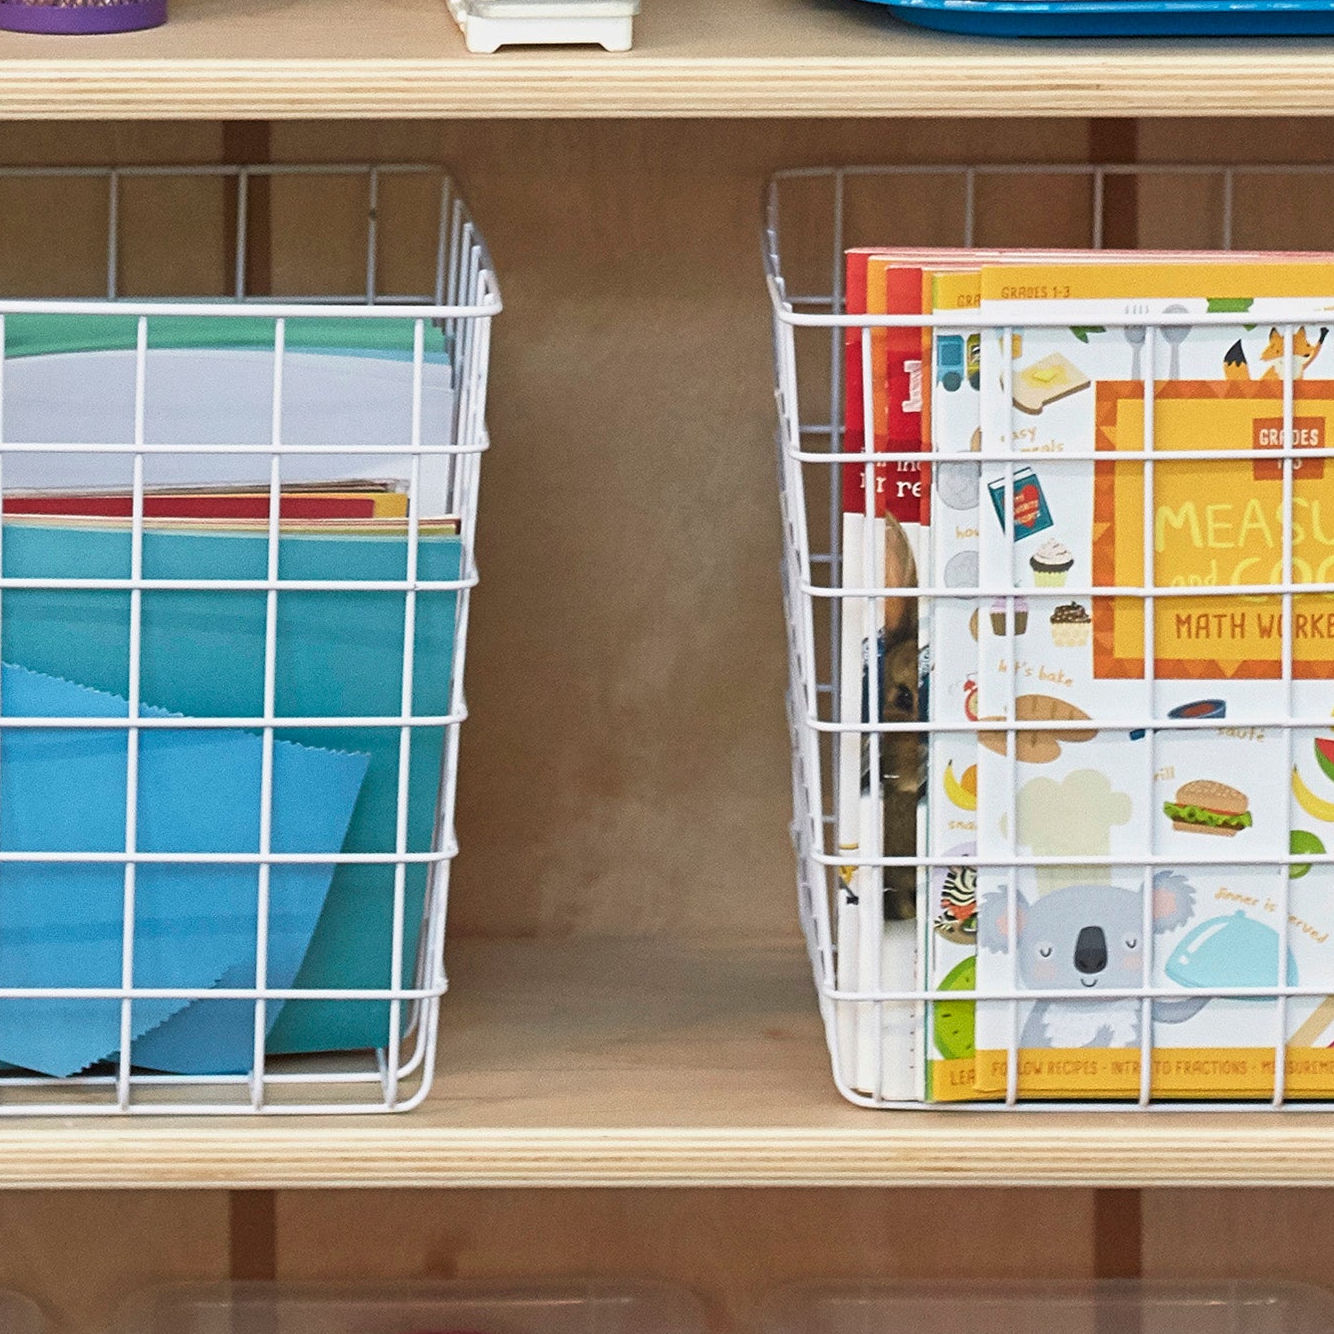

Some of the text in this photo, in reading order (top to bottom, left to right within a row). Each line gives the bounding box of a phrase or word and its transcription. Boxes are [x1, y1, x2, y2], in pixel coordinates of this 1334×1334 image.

[1001, 286, 1071, 300] GRADES 1-3
[1175, 613, 1246, 639] MATH
[1153, 765, 1175, 781] rill
[1288, 915, 1329, 944] erved
[991, 1061, 1043, 1076] FOLOW
[1111, 1061, 1142, 1075] INTR
